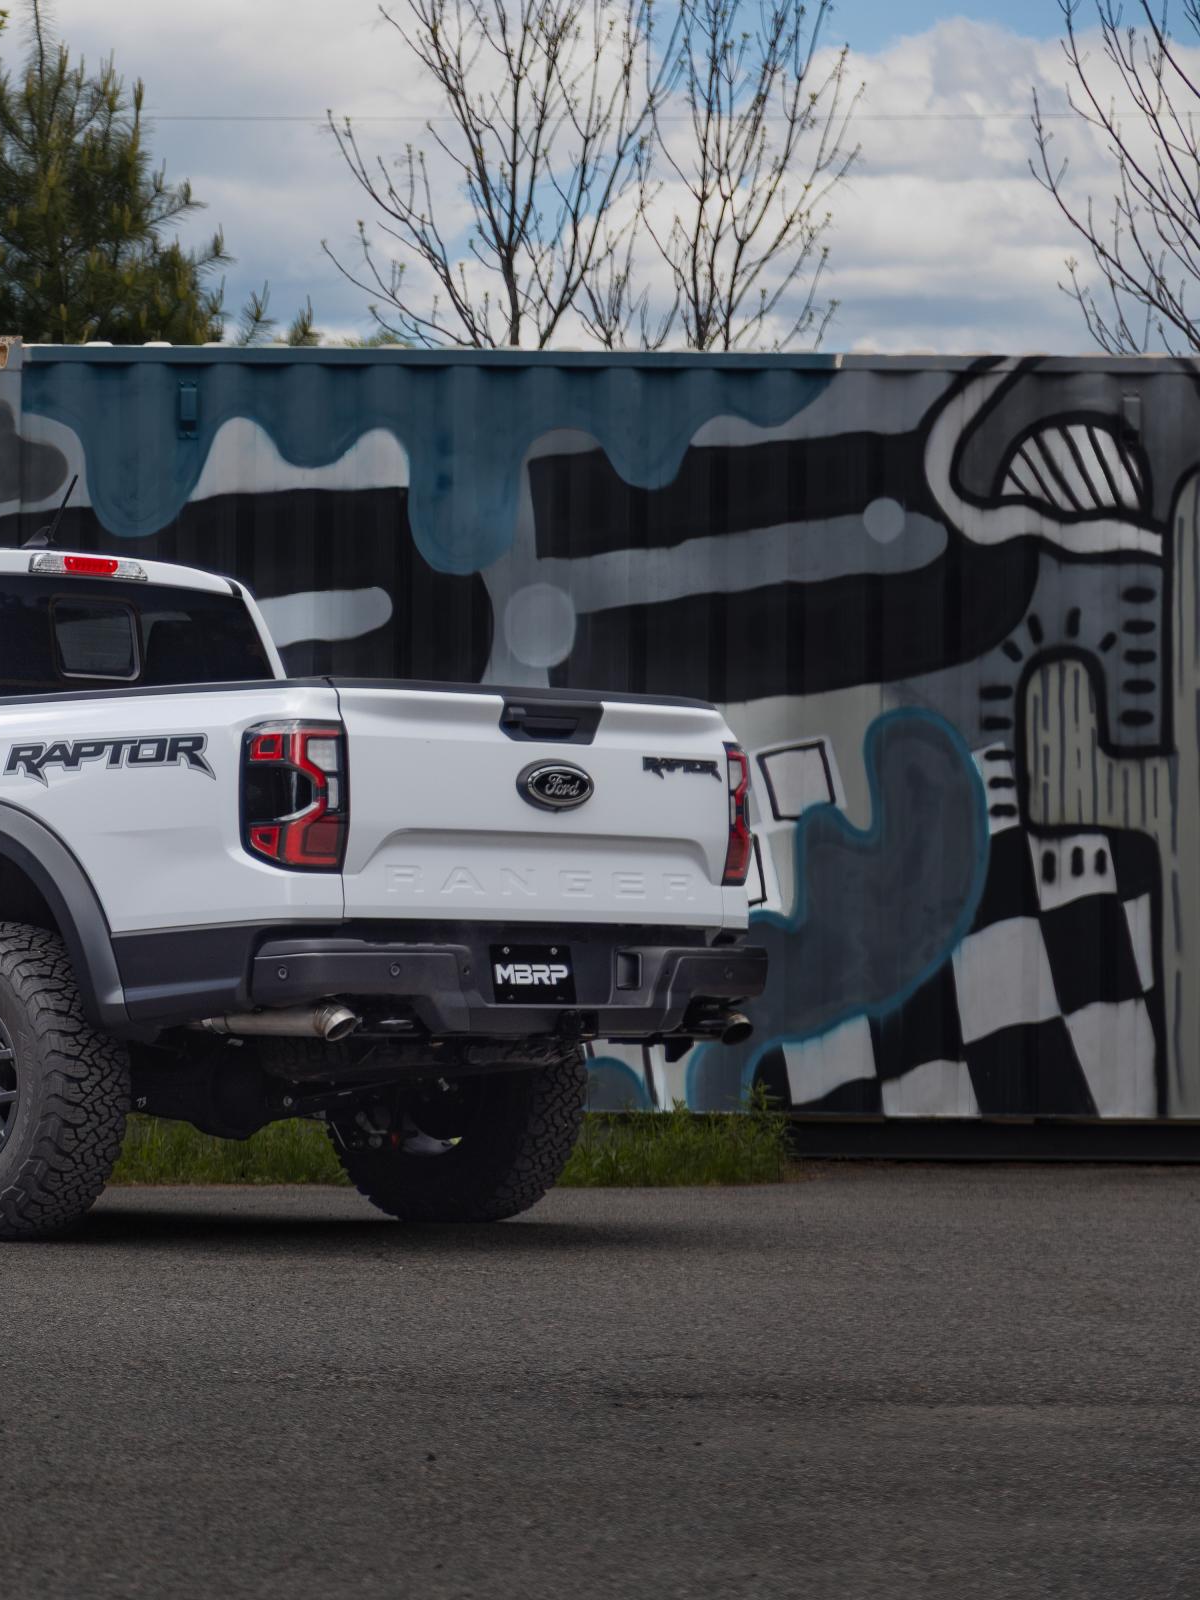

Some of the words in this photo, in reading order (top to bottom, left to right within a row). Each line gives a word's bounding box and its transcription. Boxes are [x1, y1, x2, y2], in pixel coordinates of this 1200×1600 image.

[3, 733, 216, 788] RAPTOR
[545, 774, 580, 795] Ford
[384, 864, 699, 902] RANGER
[494, 963, 569, 985] MBRP
